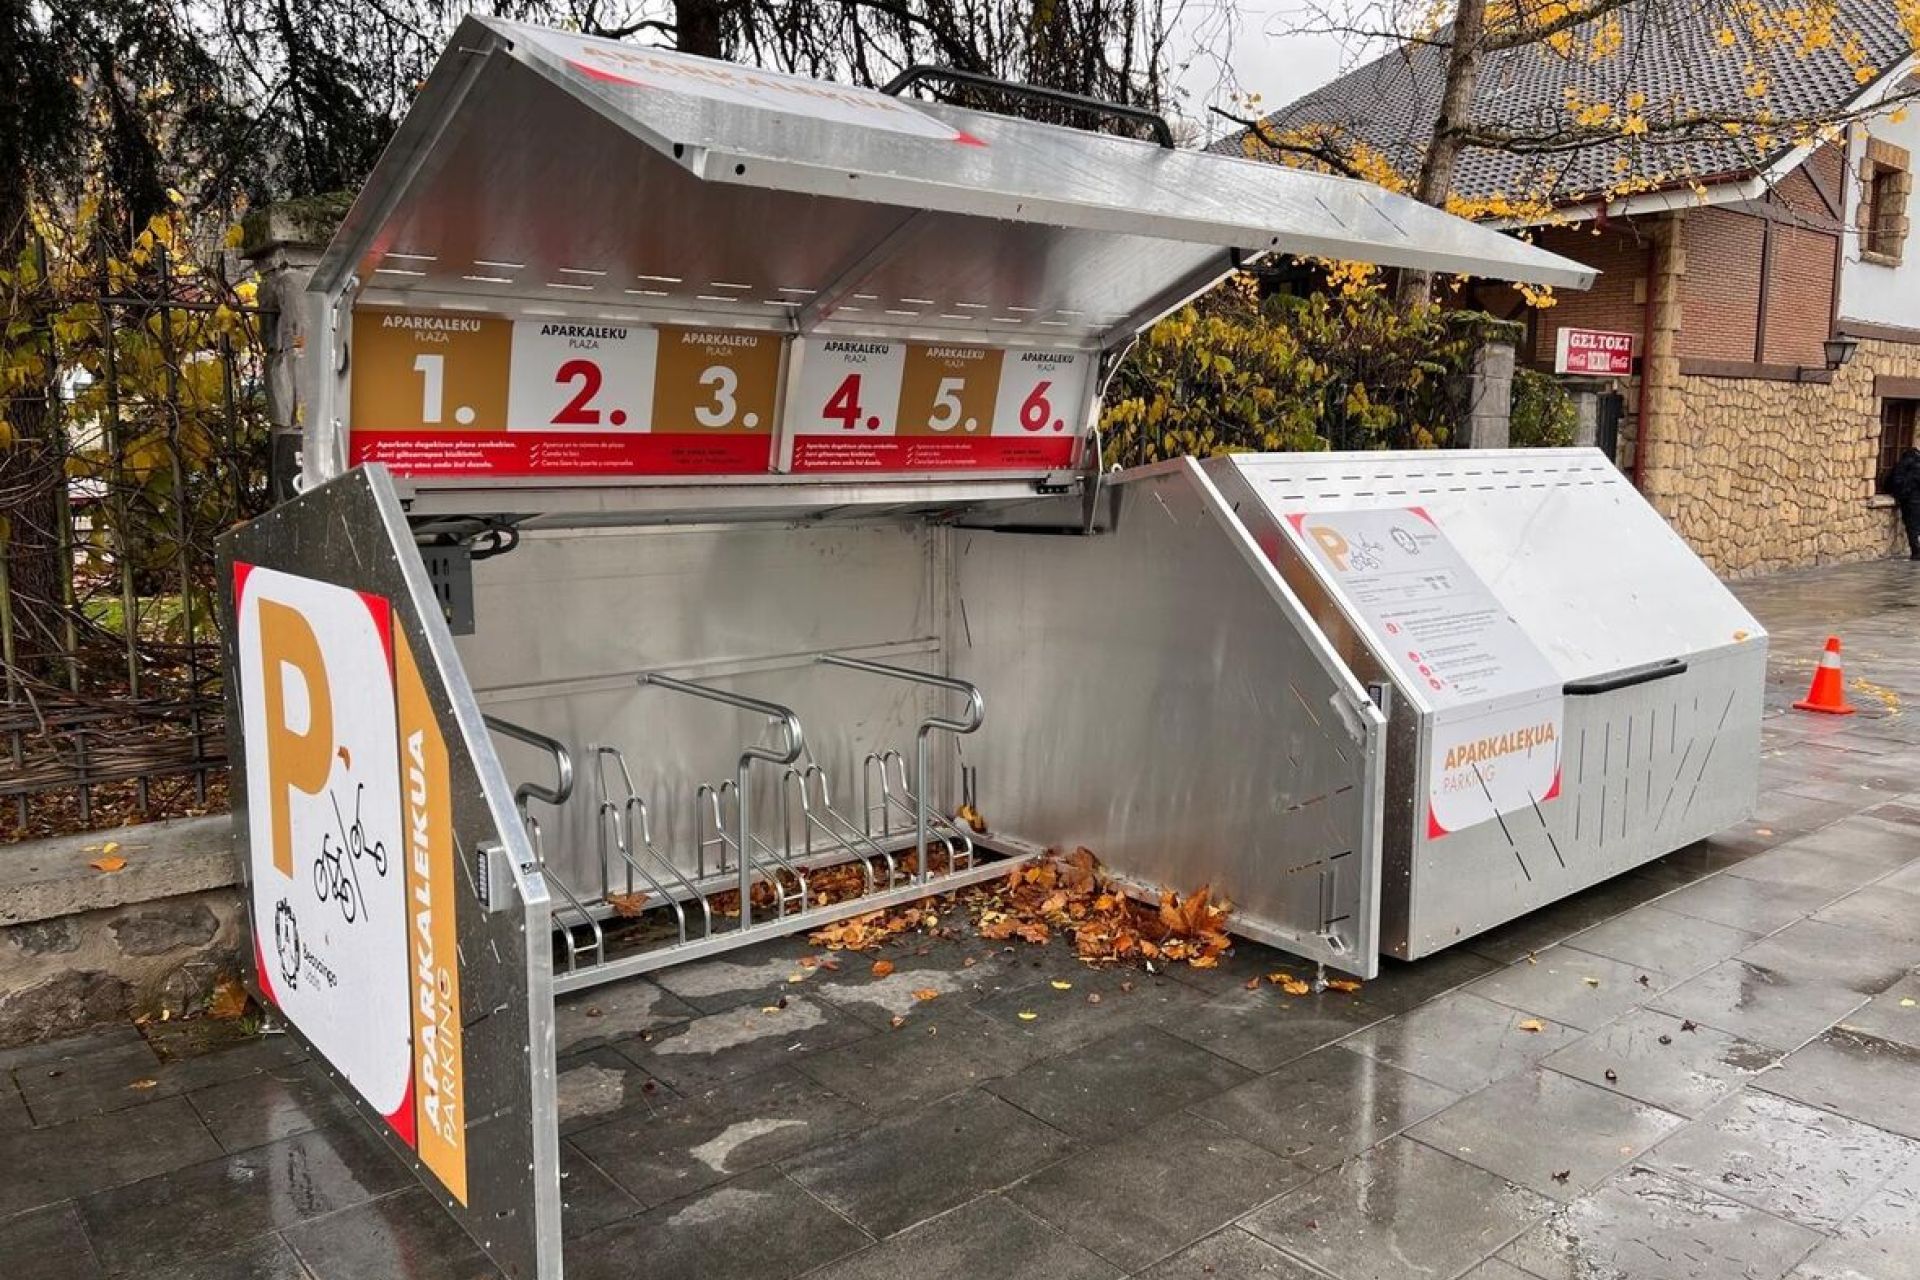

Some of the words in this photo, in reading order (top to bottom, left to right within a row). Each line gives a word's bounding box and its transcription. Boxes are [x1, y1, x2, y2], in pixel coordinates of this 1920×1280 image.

[382, 314, 481, 333] APARKALEKU
[541, 323, 628, 340] APARKALEKU
[414, 331, 449, 343] PLAZA
[568, 338, 600, 350] PLAZA
[681, 331, 758, 348] APARKALEKU
[1570, 333, 1630, 351] GELTOKI
[705, 346, 733, 357] PLAZA
[824, 340, 889, 355] APARKALEKU
[926, 347, 985, 360] APARKALEKU
[843, 353, 867, 364] PLAZA
[944, 358, 966, 369] PLAZA
[1020, 352, 1075, 364] APARKALEKU
[1308, 526, 1349, 572] P
[258, 597, 333, 879] P
[1444, 722, 1555, 770] APARKALEKUA
[1443, 763, 1496, 793] PARKING
[407, 728, 441, 1135] APARKALEKUA
[437, 965, 460, 1148] PARKING
